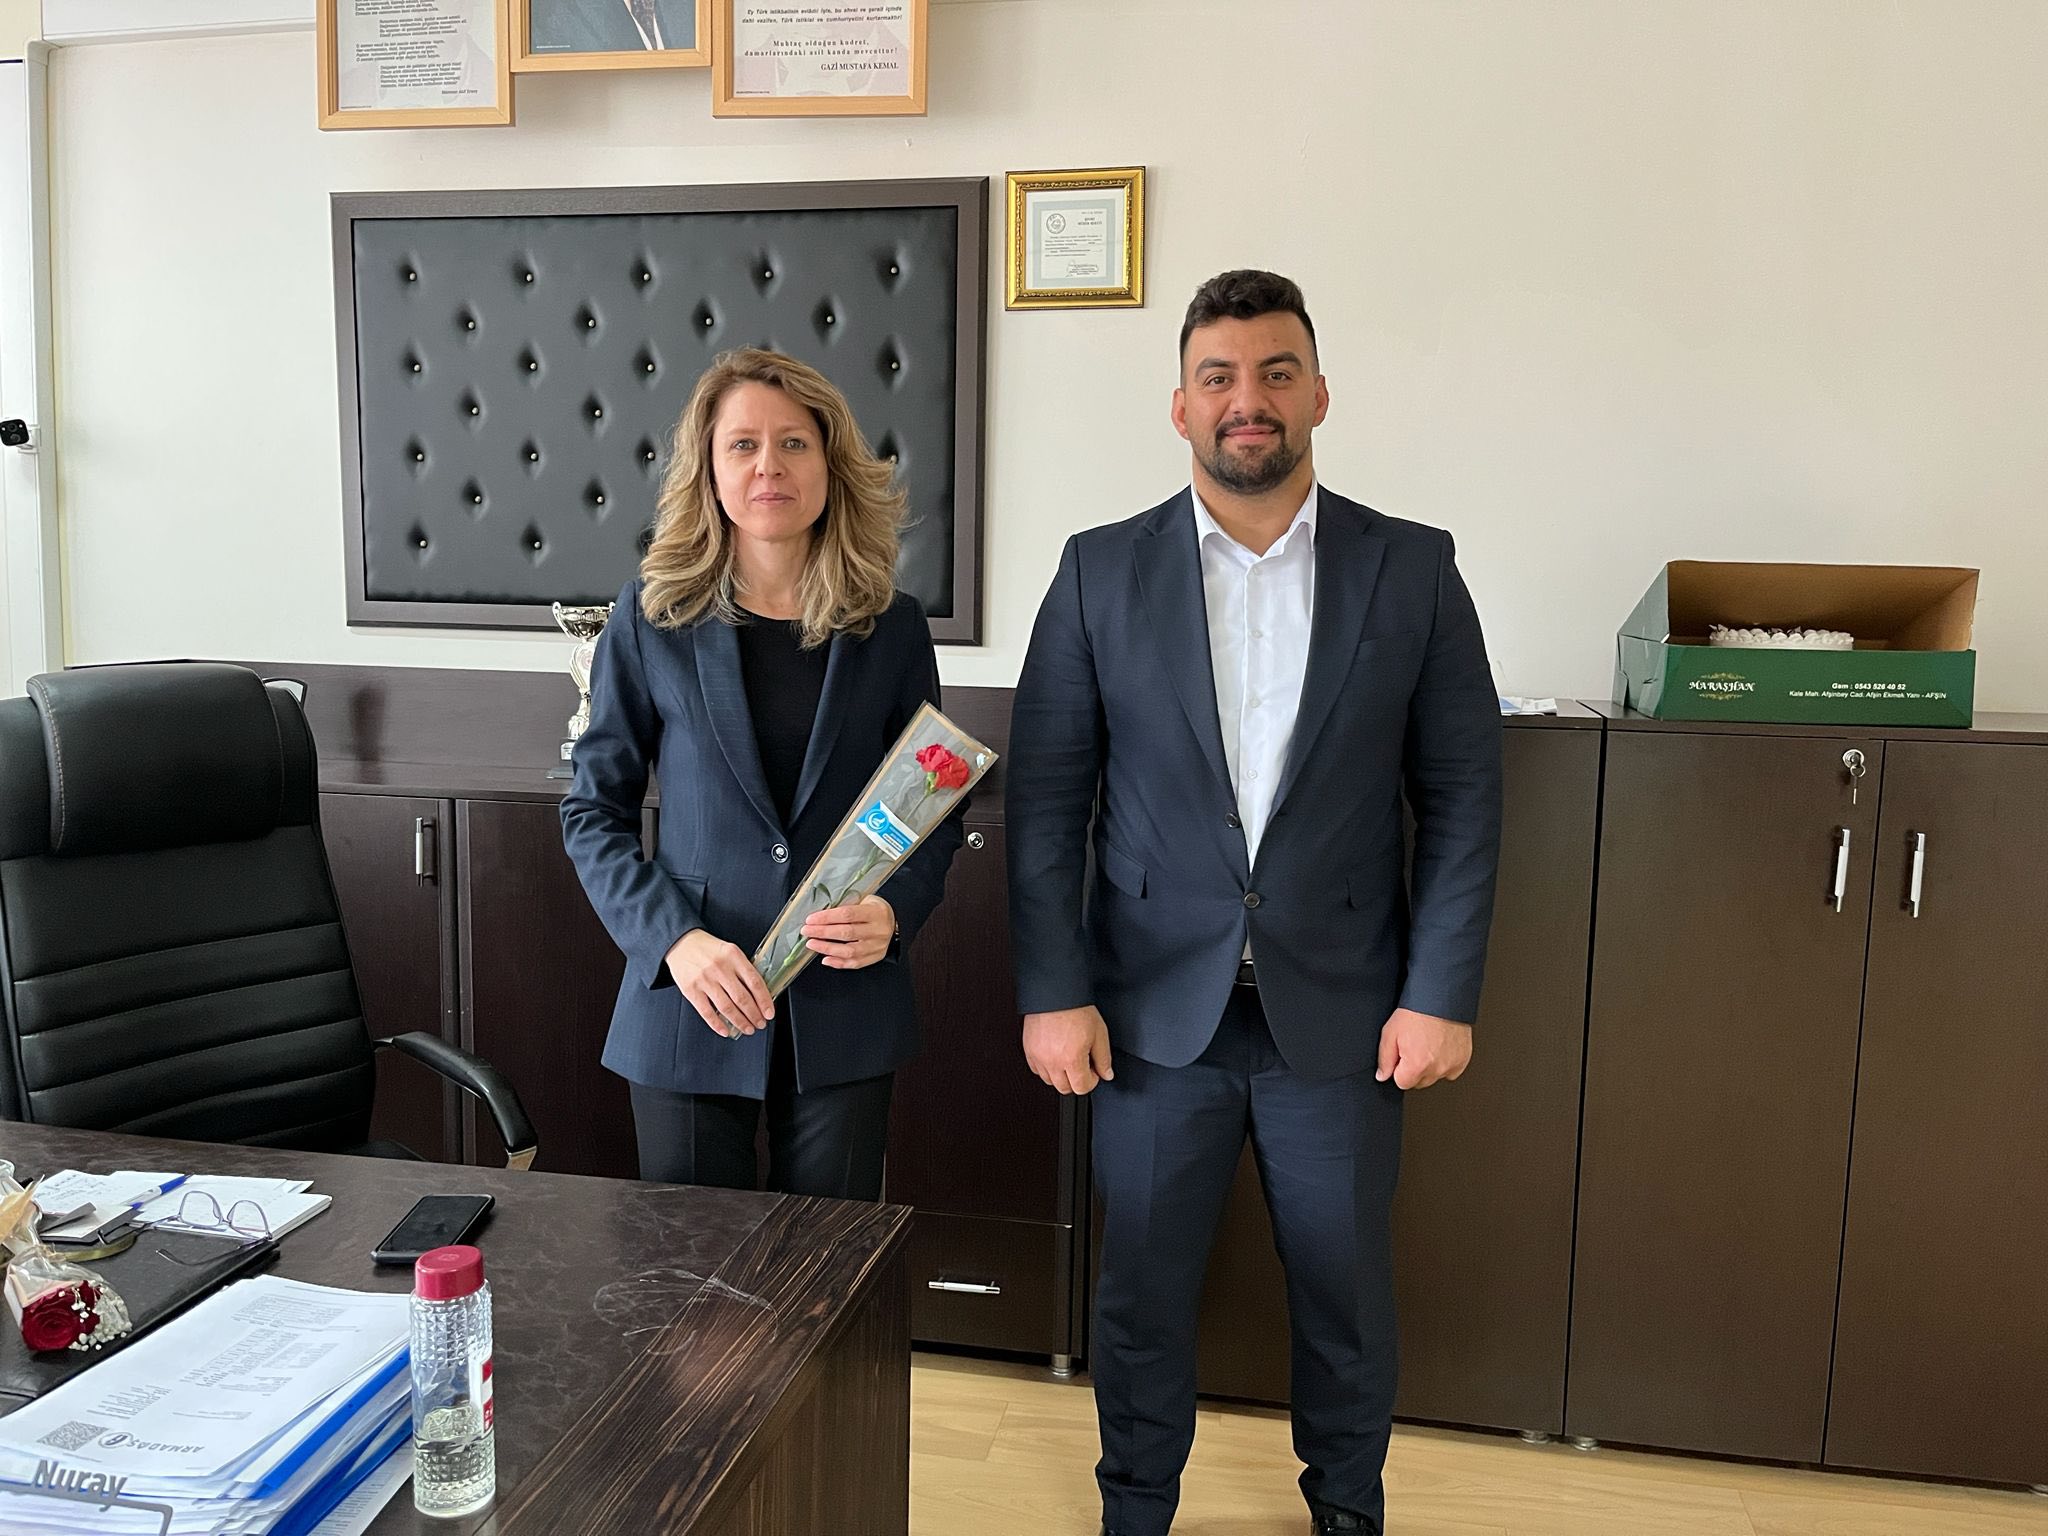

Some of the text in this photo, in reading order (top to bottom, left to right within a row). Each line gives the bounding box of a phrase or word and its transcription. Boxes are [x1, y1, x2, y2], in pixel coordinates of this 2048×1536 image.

[773, 40, 802, 48] Muhtaç
[805, 39, 837, 47] olduğun
[820, 61, 899, 71] GAZİ MUSTAFA KEMAL
[33, 1459, 129, 1512] Nuray
